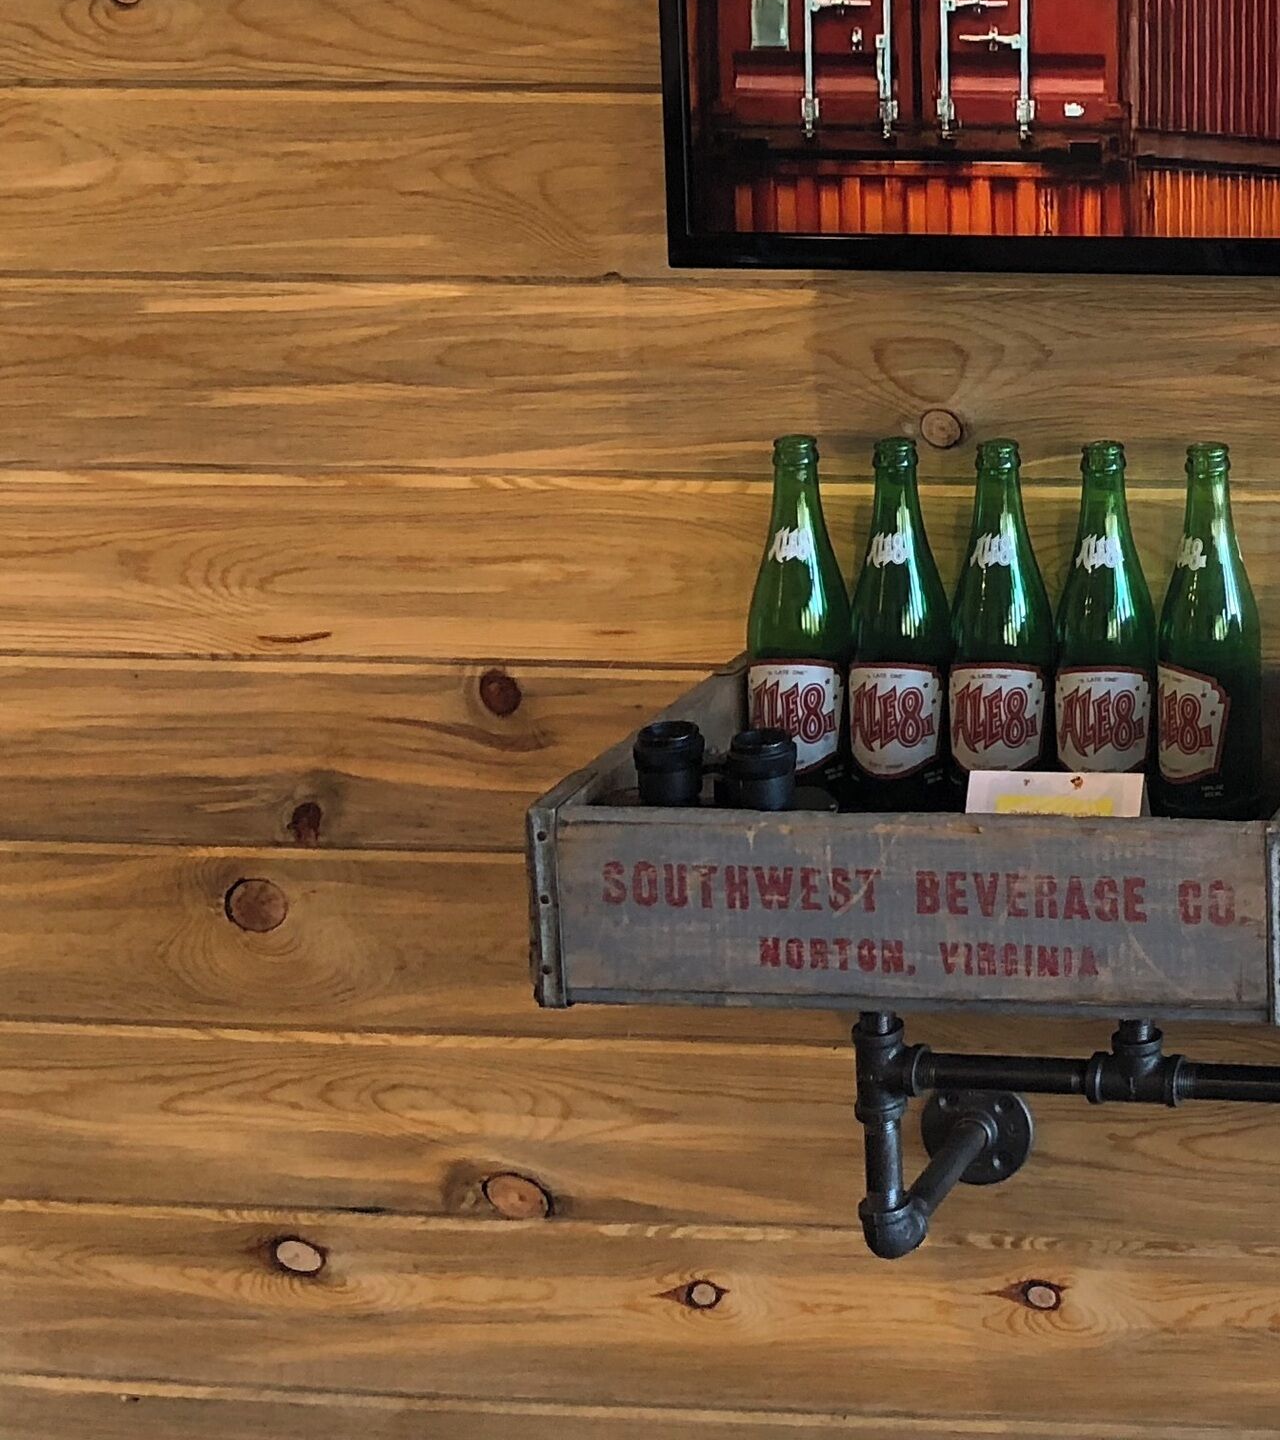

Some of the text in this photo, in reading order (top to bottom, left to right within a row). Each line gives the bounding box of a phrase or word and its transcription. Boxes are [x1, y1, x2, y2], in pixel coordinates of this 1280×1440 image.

[602, 860, 882, 914] SOUTHWEST
[917, 870, 1148, 923] BEVERAGE
[759, 936, 1102, 979] NORTON, VIRGINIA
